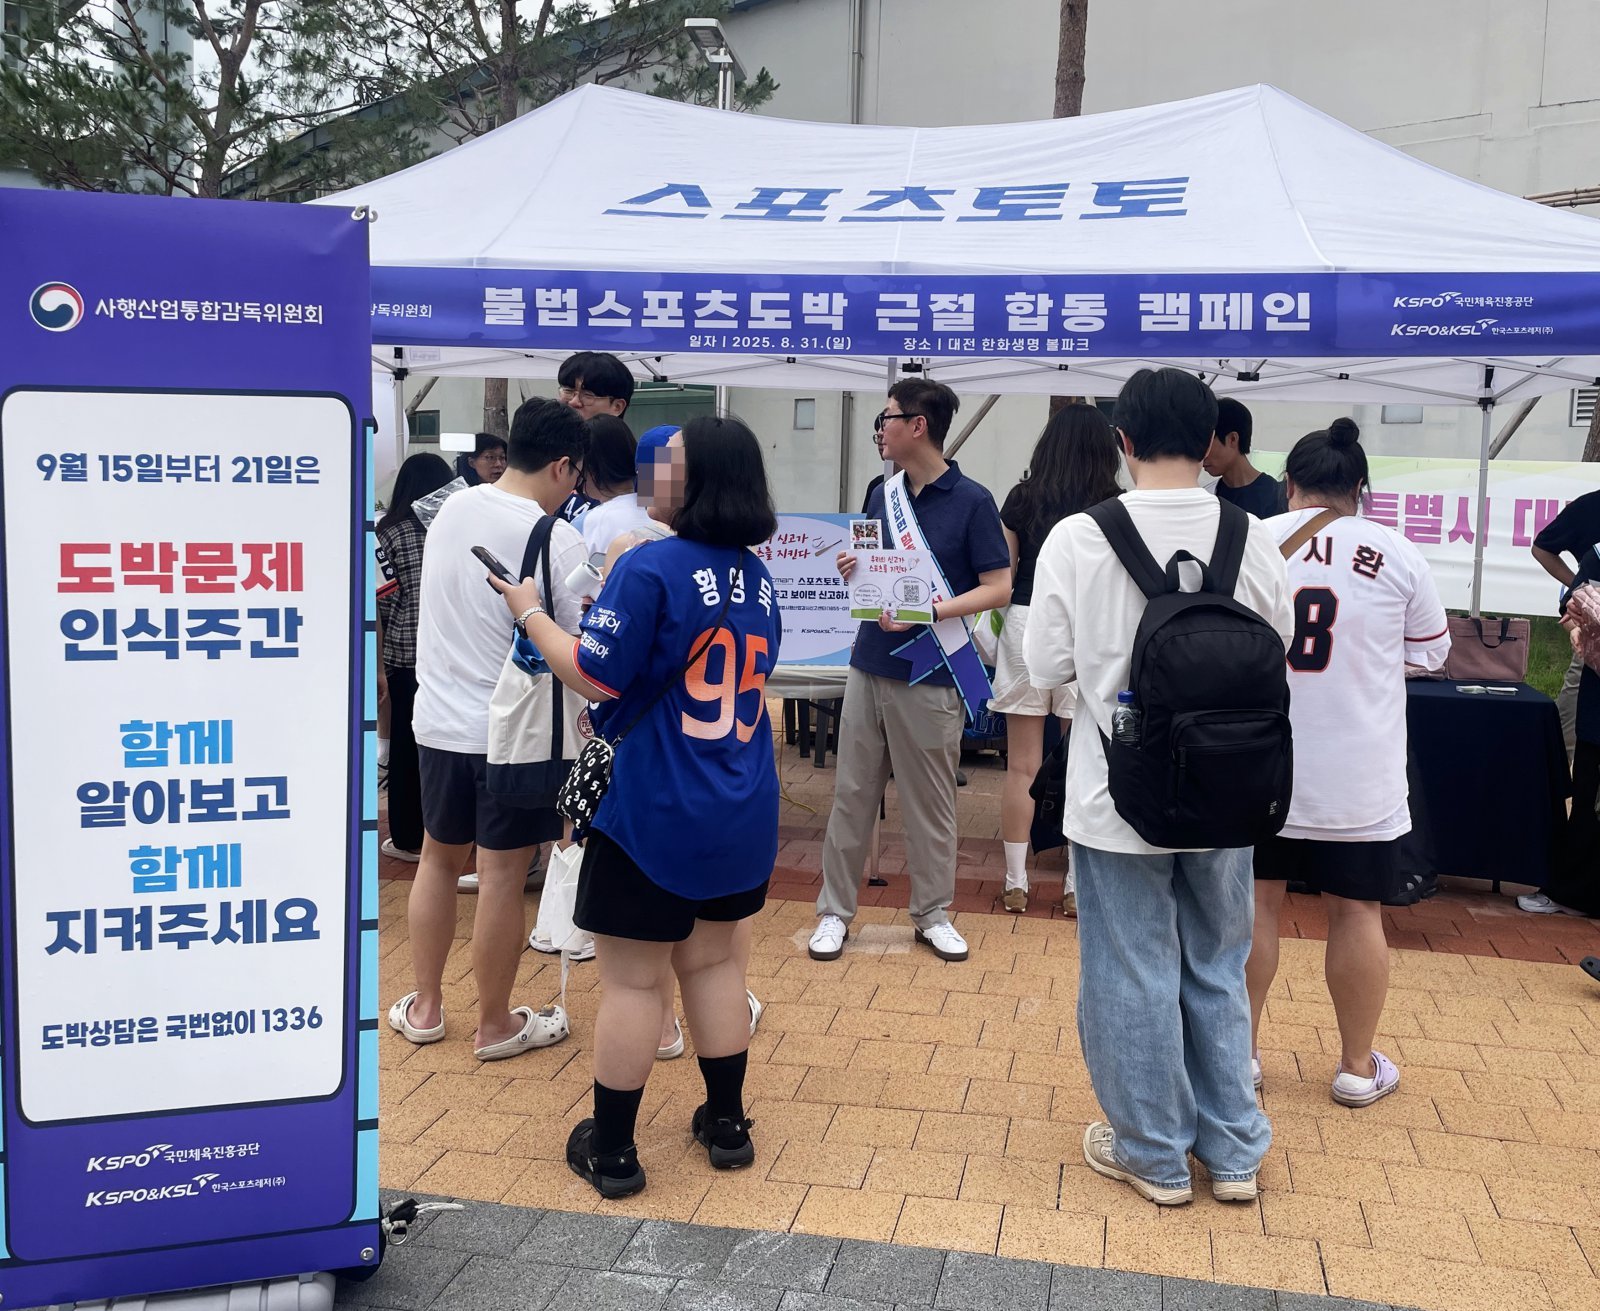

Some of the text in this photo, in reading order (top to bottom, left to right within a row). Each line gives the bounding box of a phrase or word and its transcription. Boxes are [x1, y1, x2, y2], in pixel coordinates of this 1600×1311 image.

[603, 177, 1189, 222] 스포츠토토
[95, 298, 323, 325] 사행산업통합감독위원회
[483, 288, 1311, 333] 불법스포츠도박 근절 합동 캠페인
[1393, 296, 1534, 308] KSPO 국민체육진흥공단
[689, 334, 852, 351] 일자 2025. 8. 31.(일)
[903, 337, 1090, 352] 장소 대전 한화생명 볼파크
[1391, 323, 1481, 336] KSPO&KSL
[37, 453, 321, 485] 9월 15일부터 21일은
[776, 548, 811, 560] 지킨다
[778, 533, 808, 545] 신고가
[57, 541, 304, 594] 도박문제
[798, 577, 841, 586] 스포츠토토
[791, 590, 816, 600] 보이면
[59, 607, 304, 661] 인식주간
[587, 612, 621, 634] 뉴케어
[1287, 586, 1340, 674] 8
[681, 627, 769, 743] 95
[119, 719, 233, 769] 함께
[76, 776, 291, 829] 알아보고
[128, 843, 242, 894] 함께
[44, 897, 321, 956] 지켜주세요
[41, 1006, 323, 1050] 도박상담은 국번없이 1336
[86, 1142, 261, 1172] KSPO 국민체육진흥공단
[85, 1175, 286, 1208] KSPO&KSL 한국스포츠레저(주)
